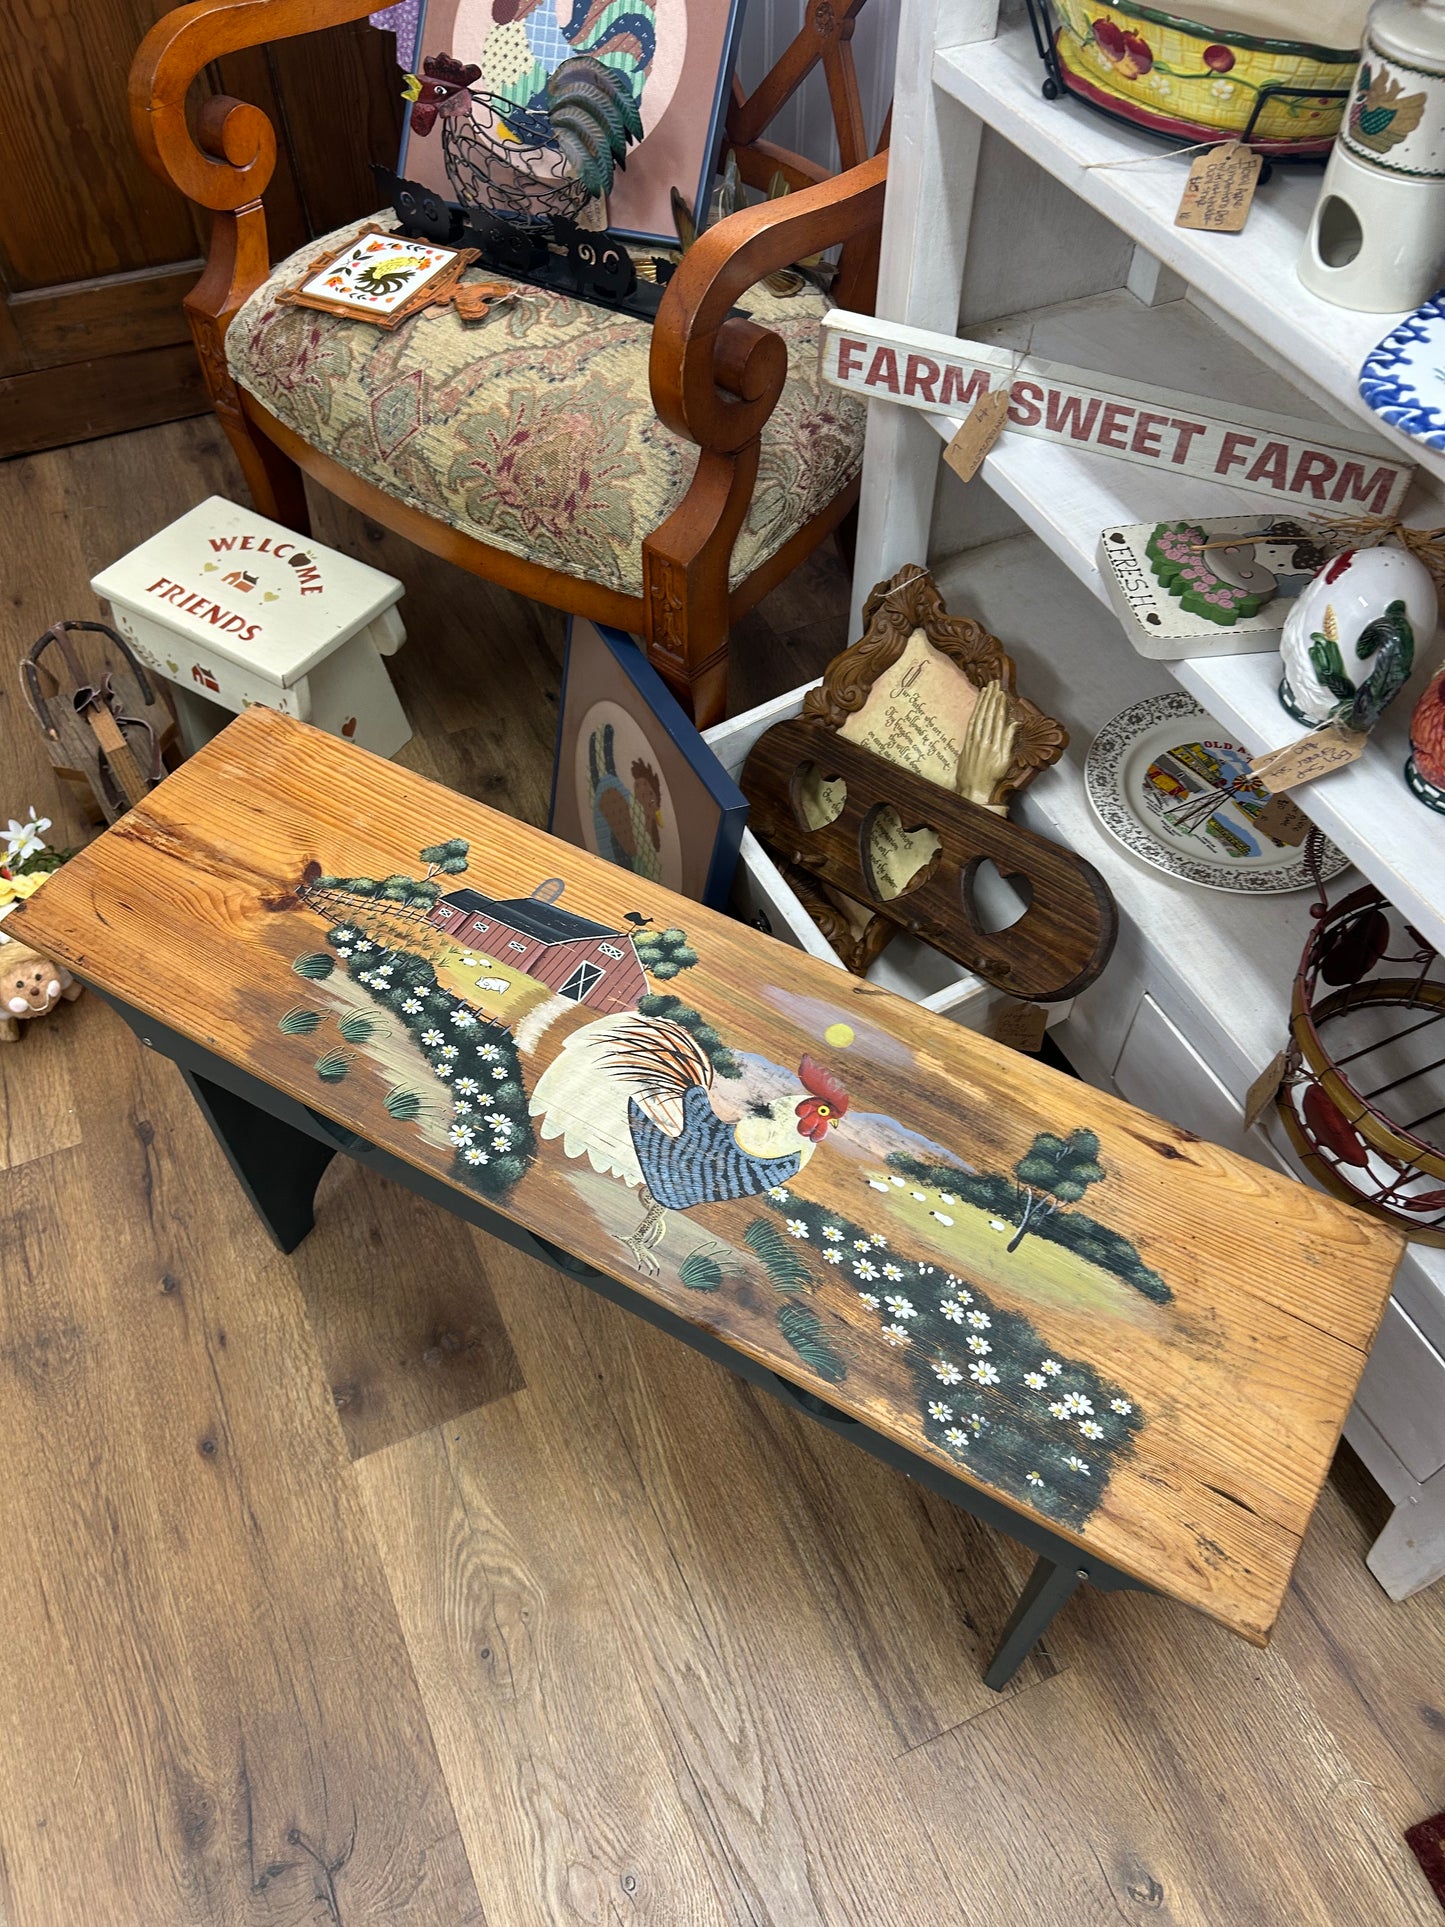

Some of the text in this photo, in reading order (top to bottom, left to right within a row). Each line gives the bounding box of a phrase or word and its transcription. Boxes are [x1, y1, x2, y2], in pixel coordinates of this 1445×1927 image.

[837, 338, 991, 405] FARM
[1007, 380, 1207, 466] SWEET
[1214, 432, 1398, 515] FARM
[1109, 546, 1157, 608] FRESH
[145, 577, 263, 641] FRIENDS
[909, 693, 927, 716] Father
[1203, 740, 1233, 750] OLD
